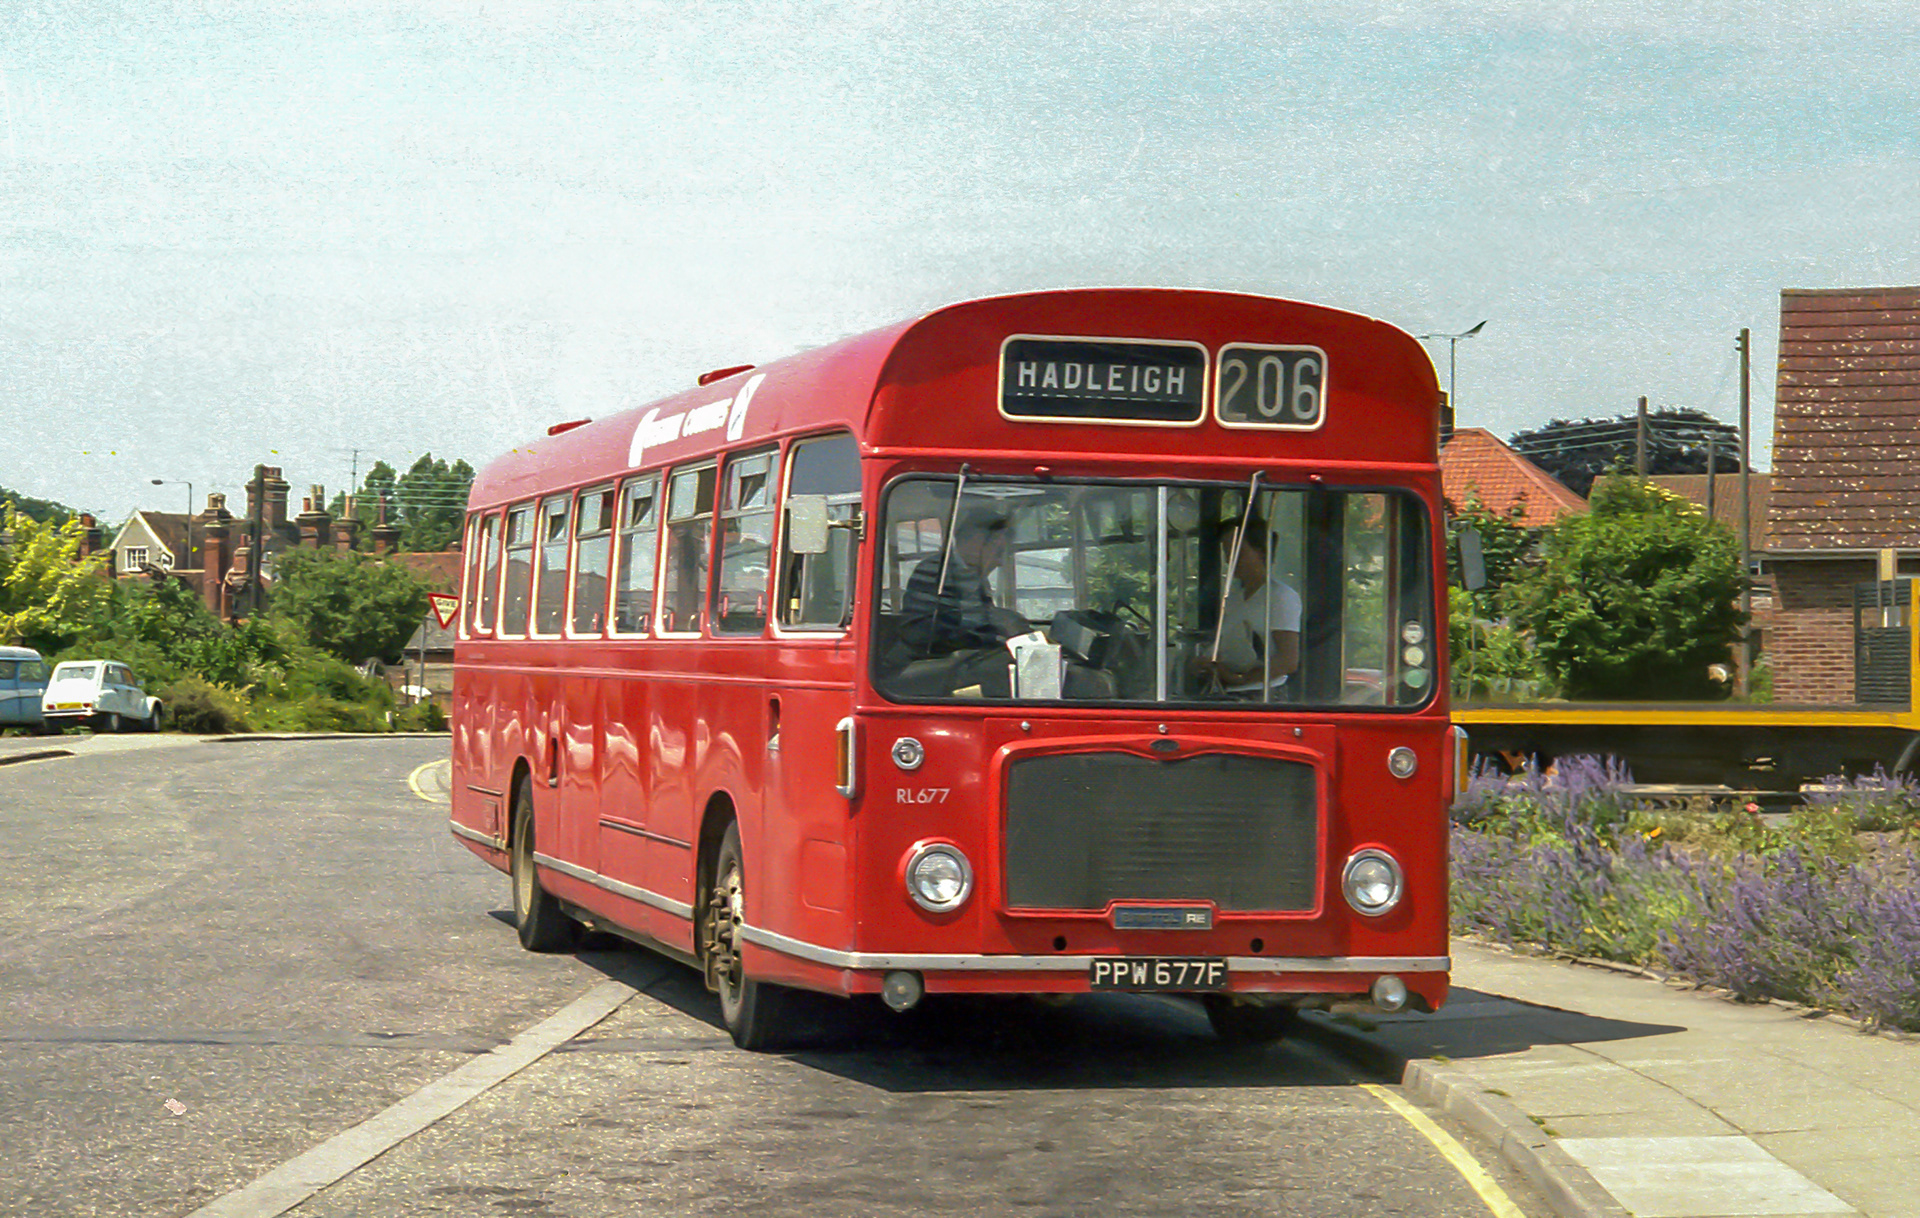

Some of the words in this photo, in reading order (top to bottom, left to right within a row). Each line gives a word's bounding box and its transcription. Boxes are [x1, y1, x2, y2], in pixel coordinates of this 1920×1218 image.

[1017, 360, 1186, 395] HADLEIGH
[1220, 355, 1320, 421] 206
[896, 788, 951, 804] RL677
[1095, 962, 1148, 985] PPW
[1155, 962, 1225, 985] 677F
